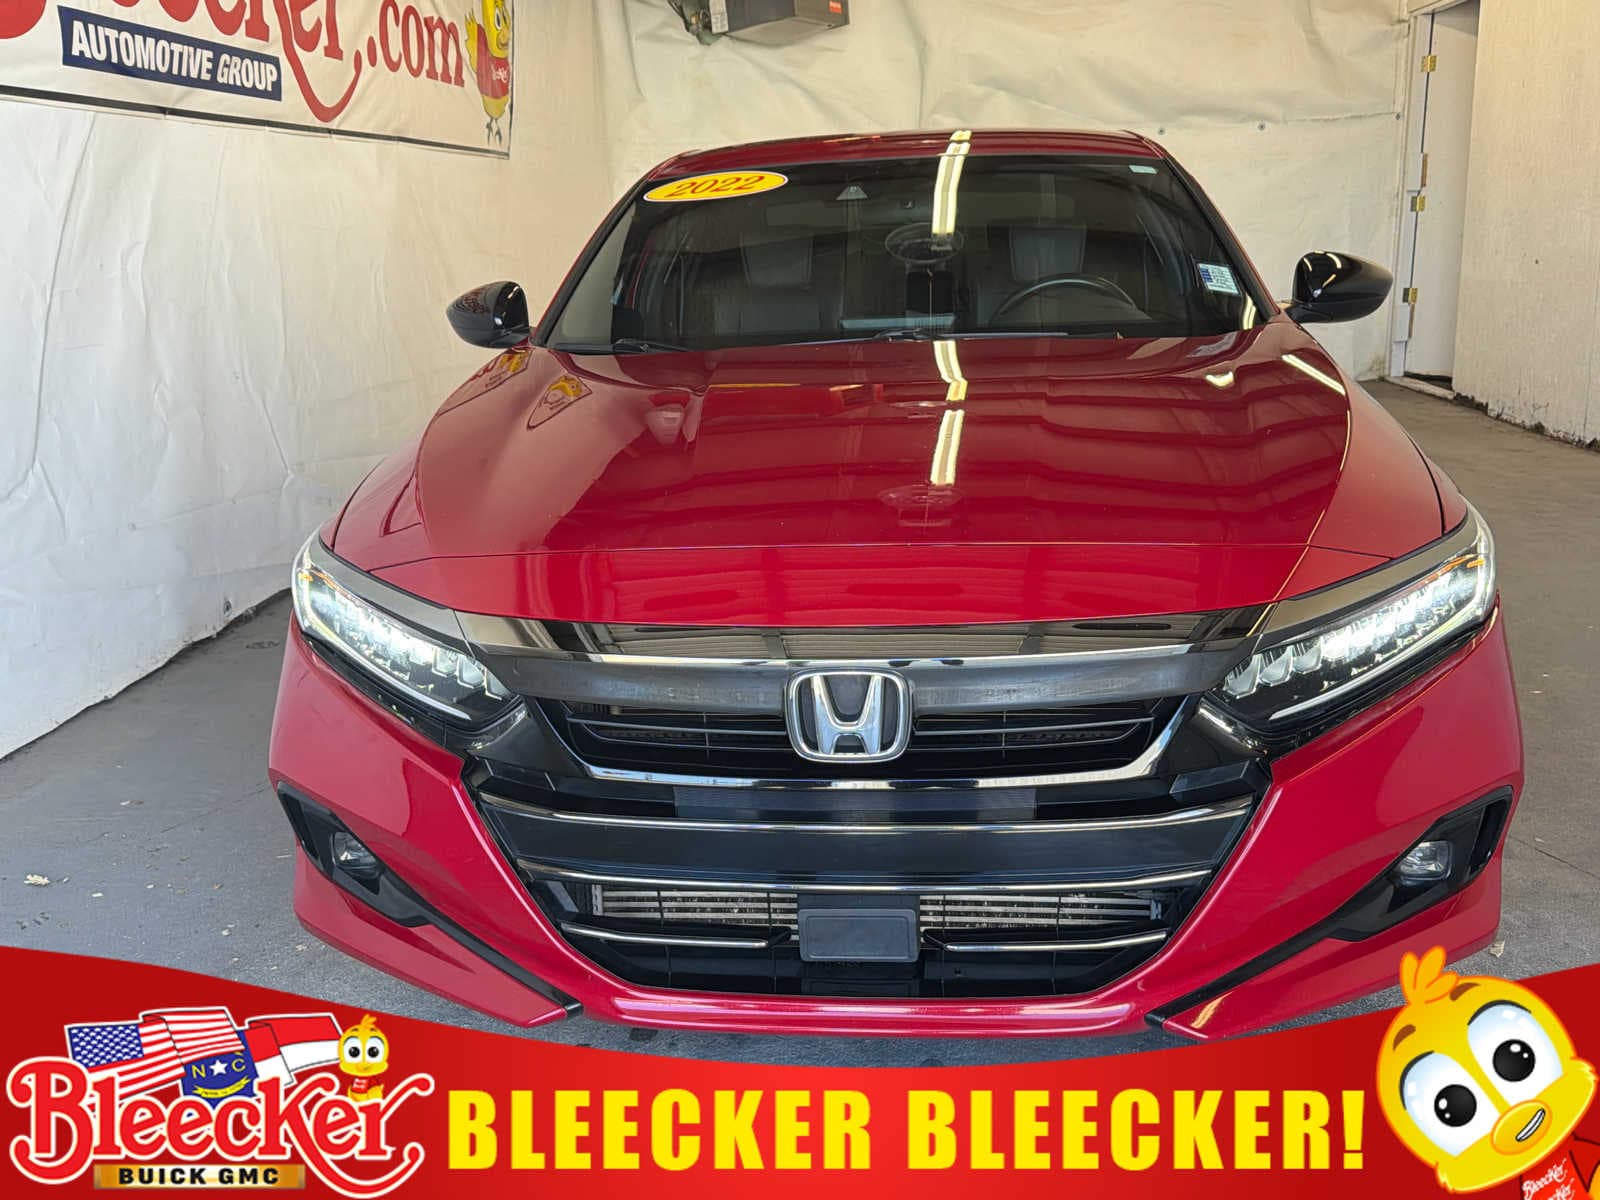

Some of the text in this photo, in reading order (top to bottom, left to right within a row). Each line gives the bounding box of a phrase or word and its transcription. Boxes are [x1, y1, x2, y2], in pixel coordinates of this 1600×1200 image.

[71, 20, 278, 92] AUTOMOTIVE GROUP
[664, 175, 765, 198] 2022
